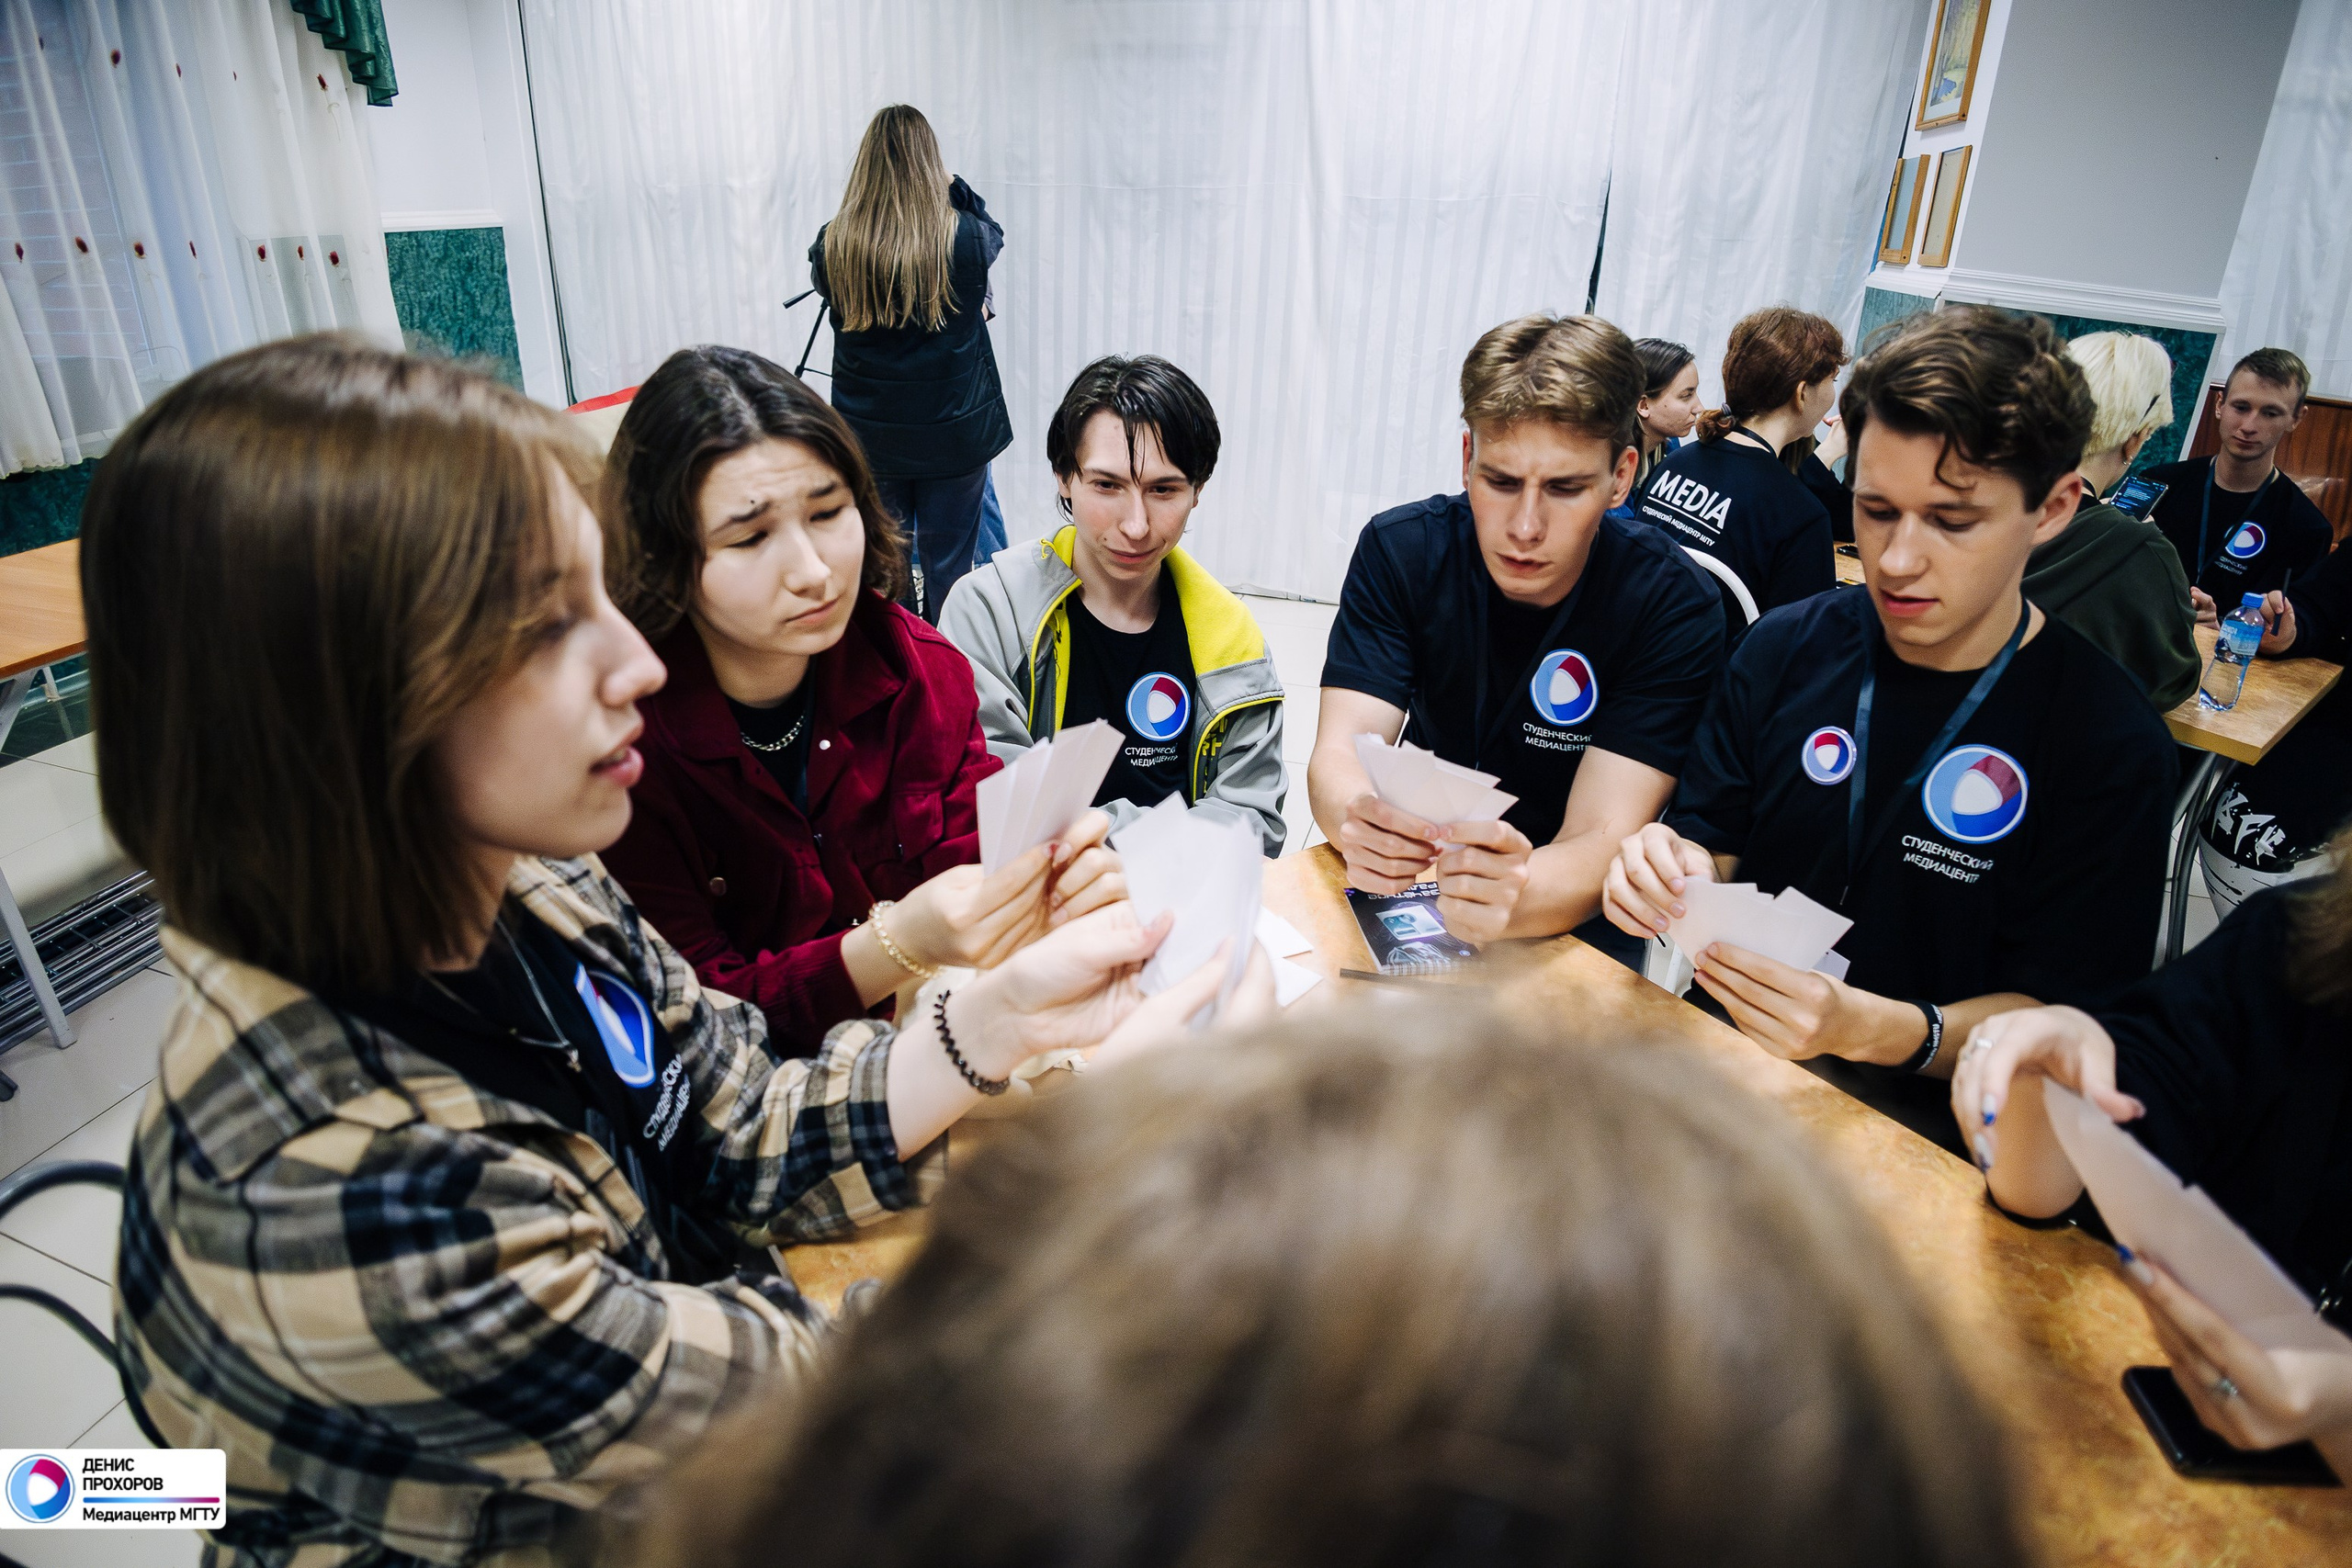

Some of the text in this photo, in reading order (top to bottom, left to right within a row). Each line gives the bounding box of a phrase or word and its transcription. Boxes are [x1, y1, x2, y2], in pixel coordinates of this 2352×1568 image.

[1649, 469, 1733, 530] MEDIA
[1670, 518, 1702, 541] МЕДИАЦЕНТР
[1699, 534, 1715, 547] МГТУ
[1125, 746, 1177, 756] СТУДЕНЧЕСК
[1130, 754, 1179, 767] МЕДИЦЕНТР
[1901, 834, 1995, 871] СТУДЕНЧЕСКИЙ
